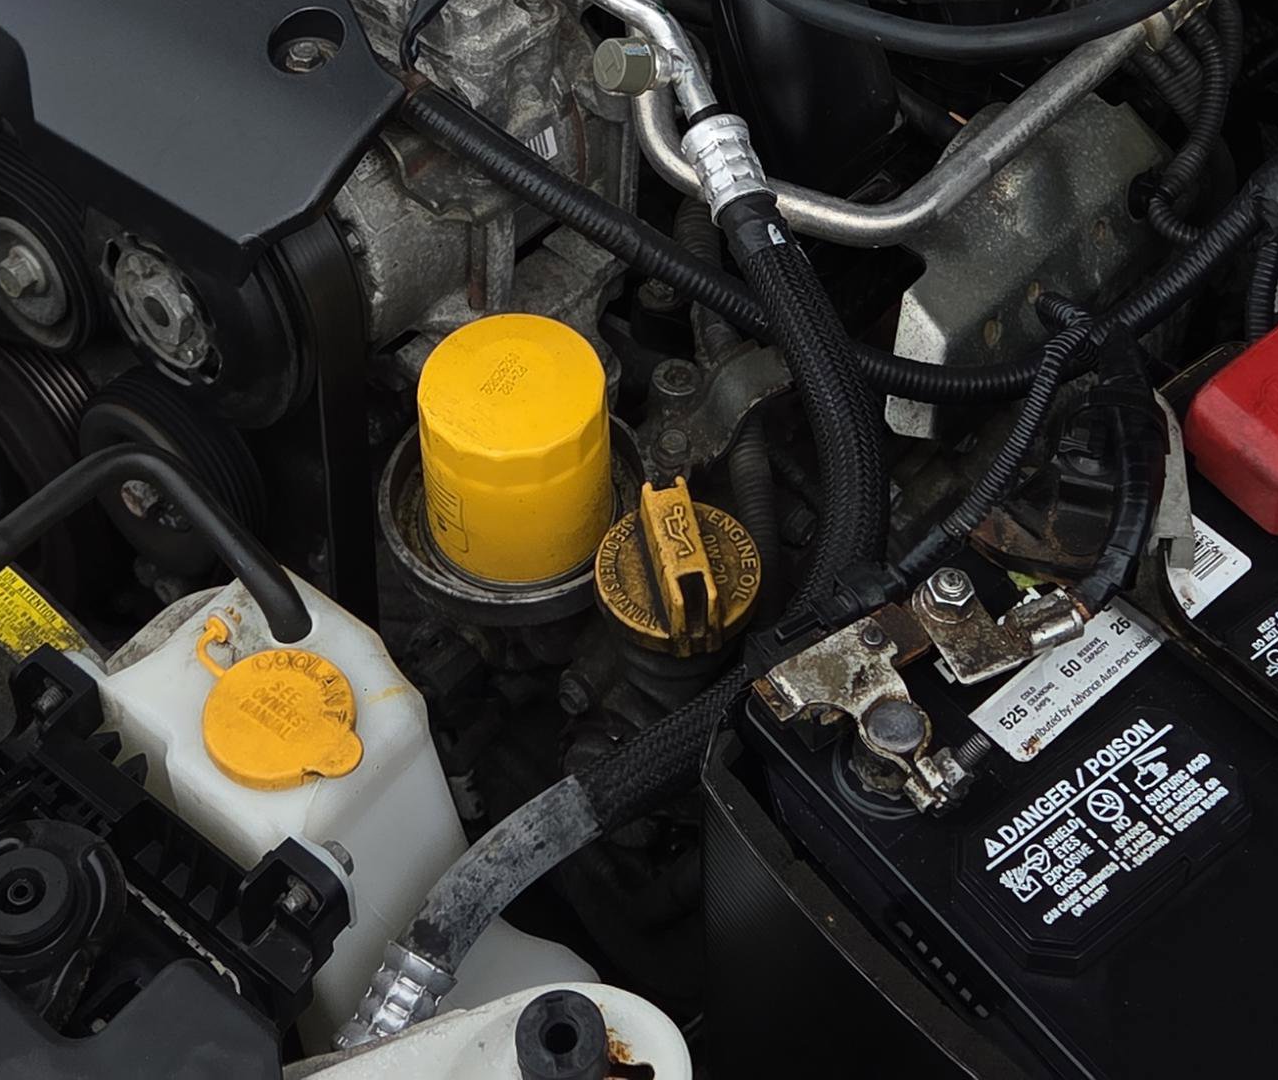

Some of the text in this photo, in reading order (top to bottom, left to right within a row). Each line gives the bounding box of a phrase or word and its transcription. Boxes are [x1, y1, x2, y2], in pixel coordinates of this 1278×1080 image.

[608, 517, 635, 542] SEE
[703, 534, 729, 584] 0W-20
[707, 510, 757, 600] ENGINE OIL
[17, 583, 58, 624] ATTENTION
[609, 592, 658, 630] MANUAL
[1257, 617, 1276, 634] KEEP
[1077, 637, 1101, 658] RESERVE
[1083, 640, 1110, 664] CAPACITY
[1251, 638, 1266, 651] DO
[253, 650, 348, 725] COOLANT
[270, 681, 302, 705] SEE
[1020, 686, 1037, 701] COLD
[1027, 682, 1055, 706] CRANKING
[1071, 680, 1103, 708] Advance
[1099, 666, 1119, 684] Auto
[239, 697, 297, 741] MANUAL
[999, 704, 1028, 730] 525
[1034, 697, 1051, 713] AMPS
[997, 719, 1155, 845] DANGER / POISON
[1145, 753, 1211, 806] SULFURIC ACID
[1155, 778, 1201, 814] CAN CAUSE
[1164, 777, 1221, 823] BLINDNESS OR
[1173, 786, 1229, 832] SEVERE BURNS
[1043, 819, 1079, 849] SHIELD
[1111, 815, 1132, 834] NO
[1053, 835, 1081, 860] EYES
[1042, 843, 1095, 886] EXPLOSIVE
[1043, 861, 1120, 925] CAN CAUSE BLINDNESS
[1053, 868, 1087, 896] GASES
[1071, 884, 1109, 917] OR INJURY
